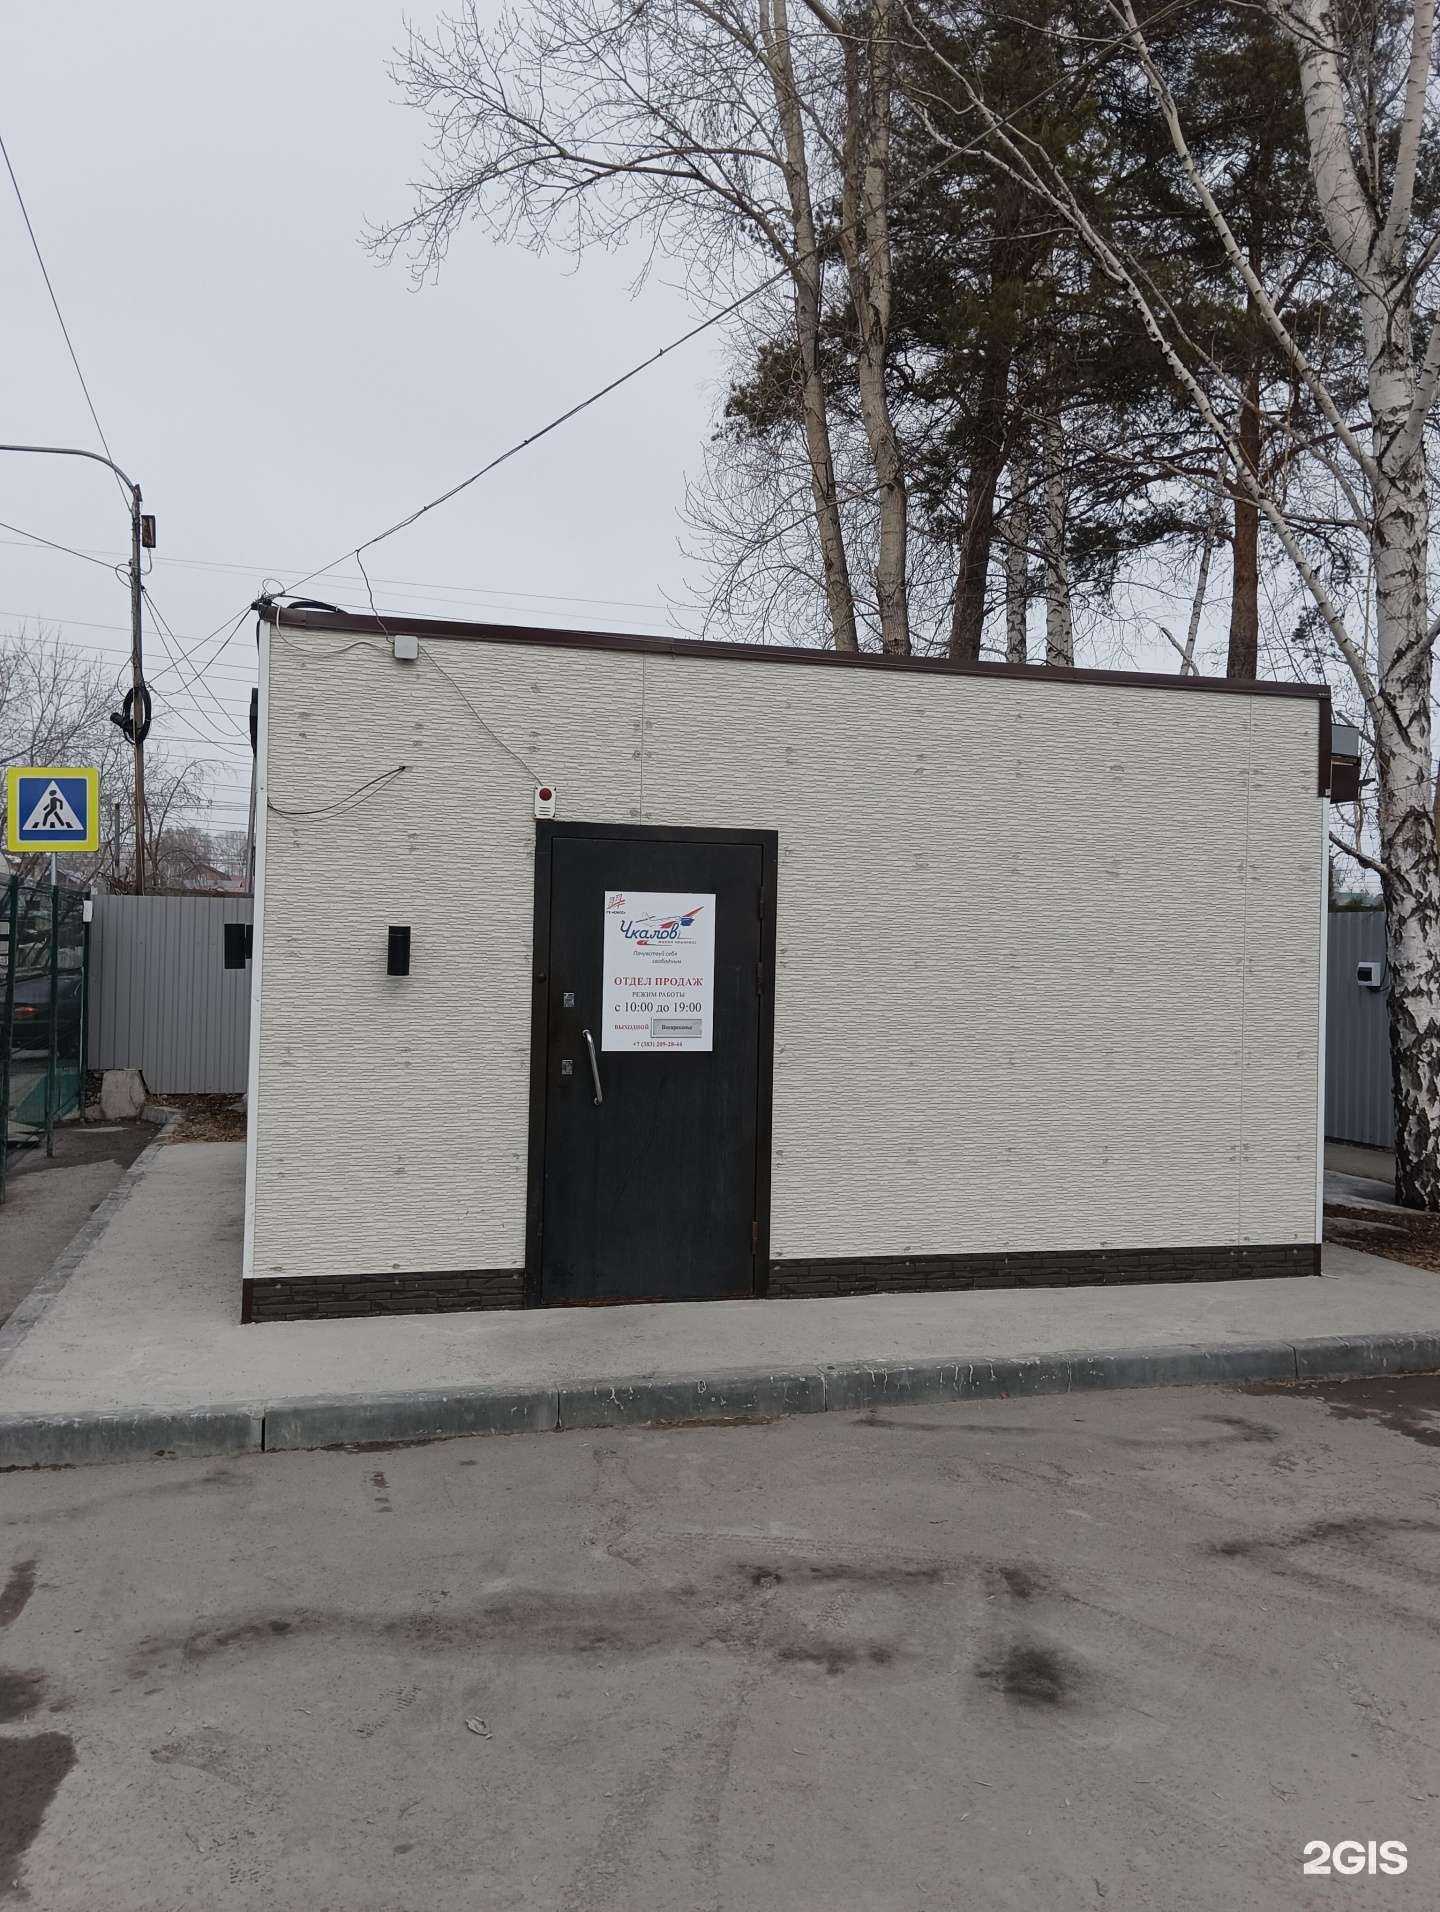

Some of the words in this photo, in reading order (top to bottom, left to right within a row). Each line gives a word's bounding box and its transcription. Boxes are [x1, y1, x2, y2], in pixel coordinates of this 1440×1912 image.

[620, 919, 680, 940] Чкалов
[614, 977, 652, 987] ОТДЕЛ
[655, 977, 704, 987] ПРОДАЖ
[614, 1004, 621, 1012] с
[624, 1002, 654, 1012] 10:00
[656, 1004, 670, 1013] до
[674, 1002, 702, 1012] 19:00
